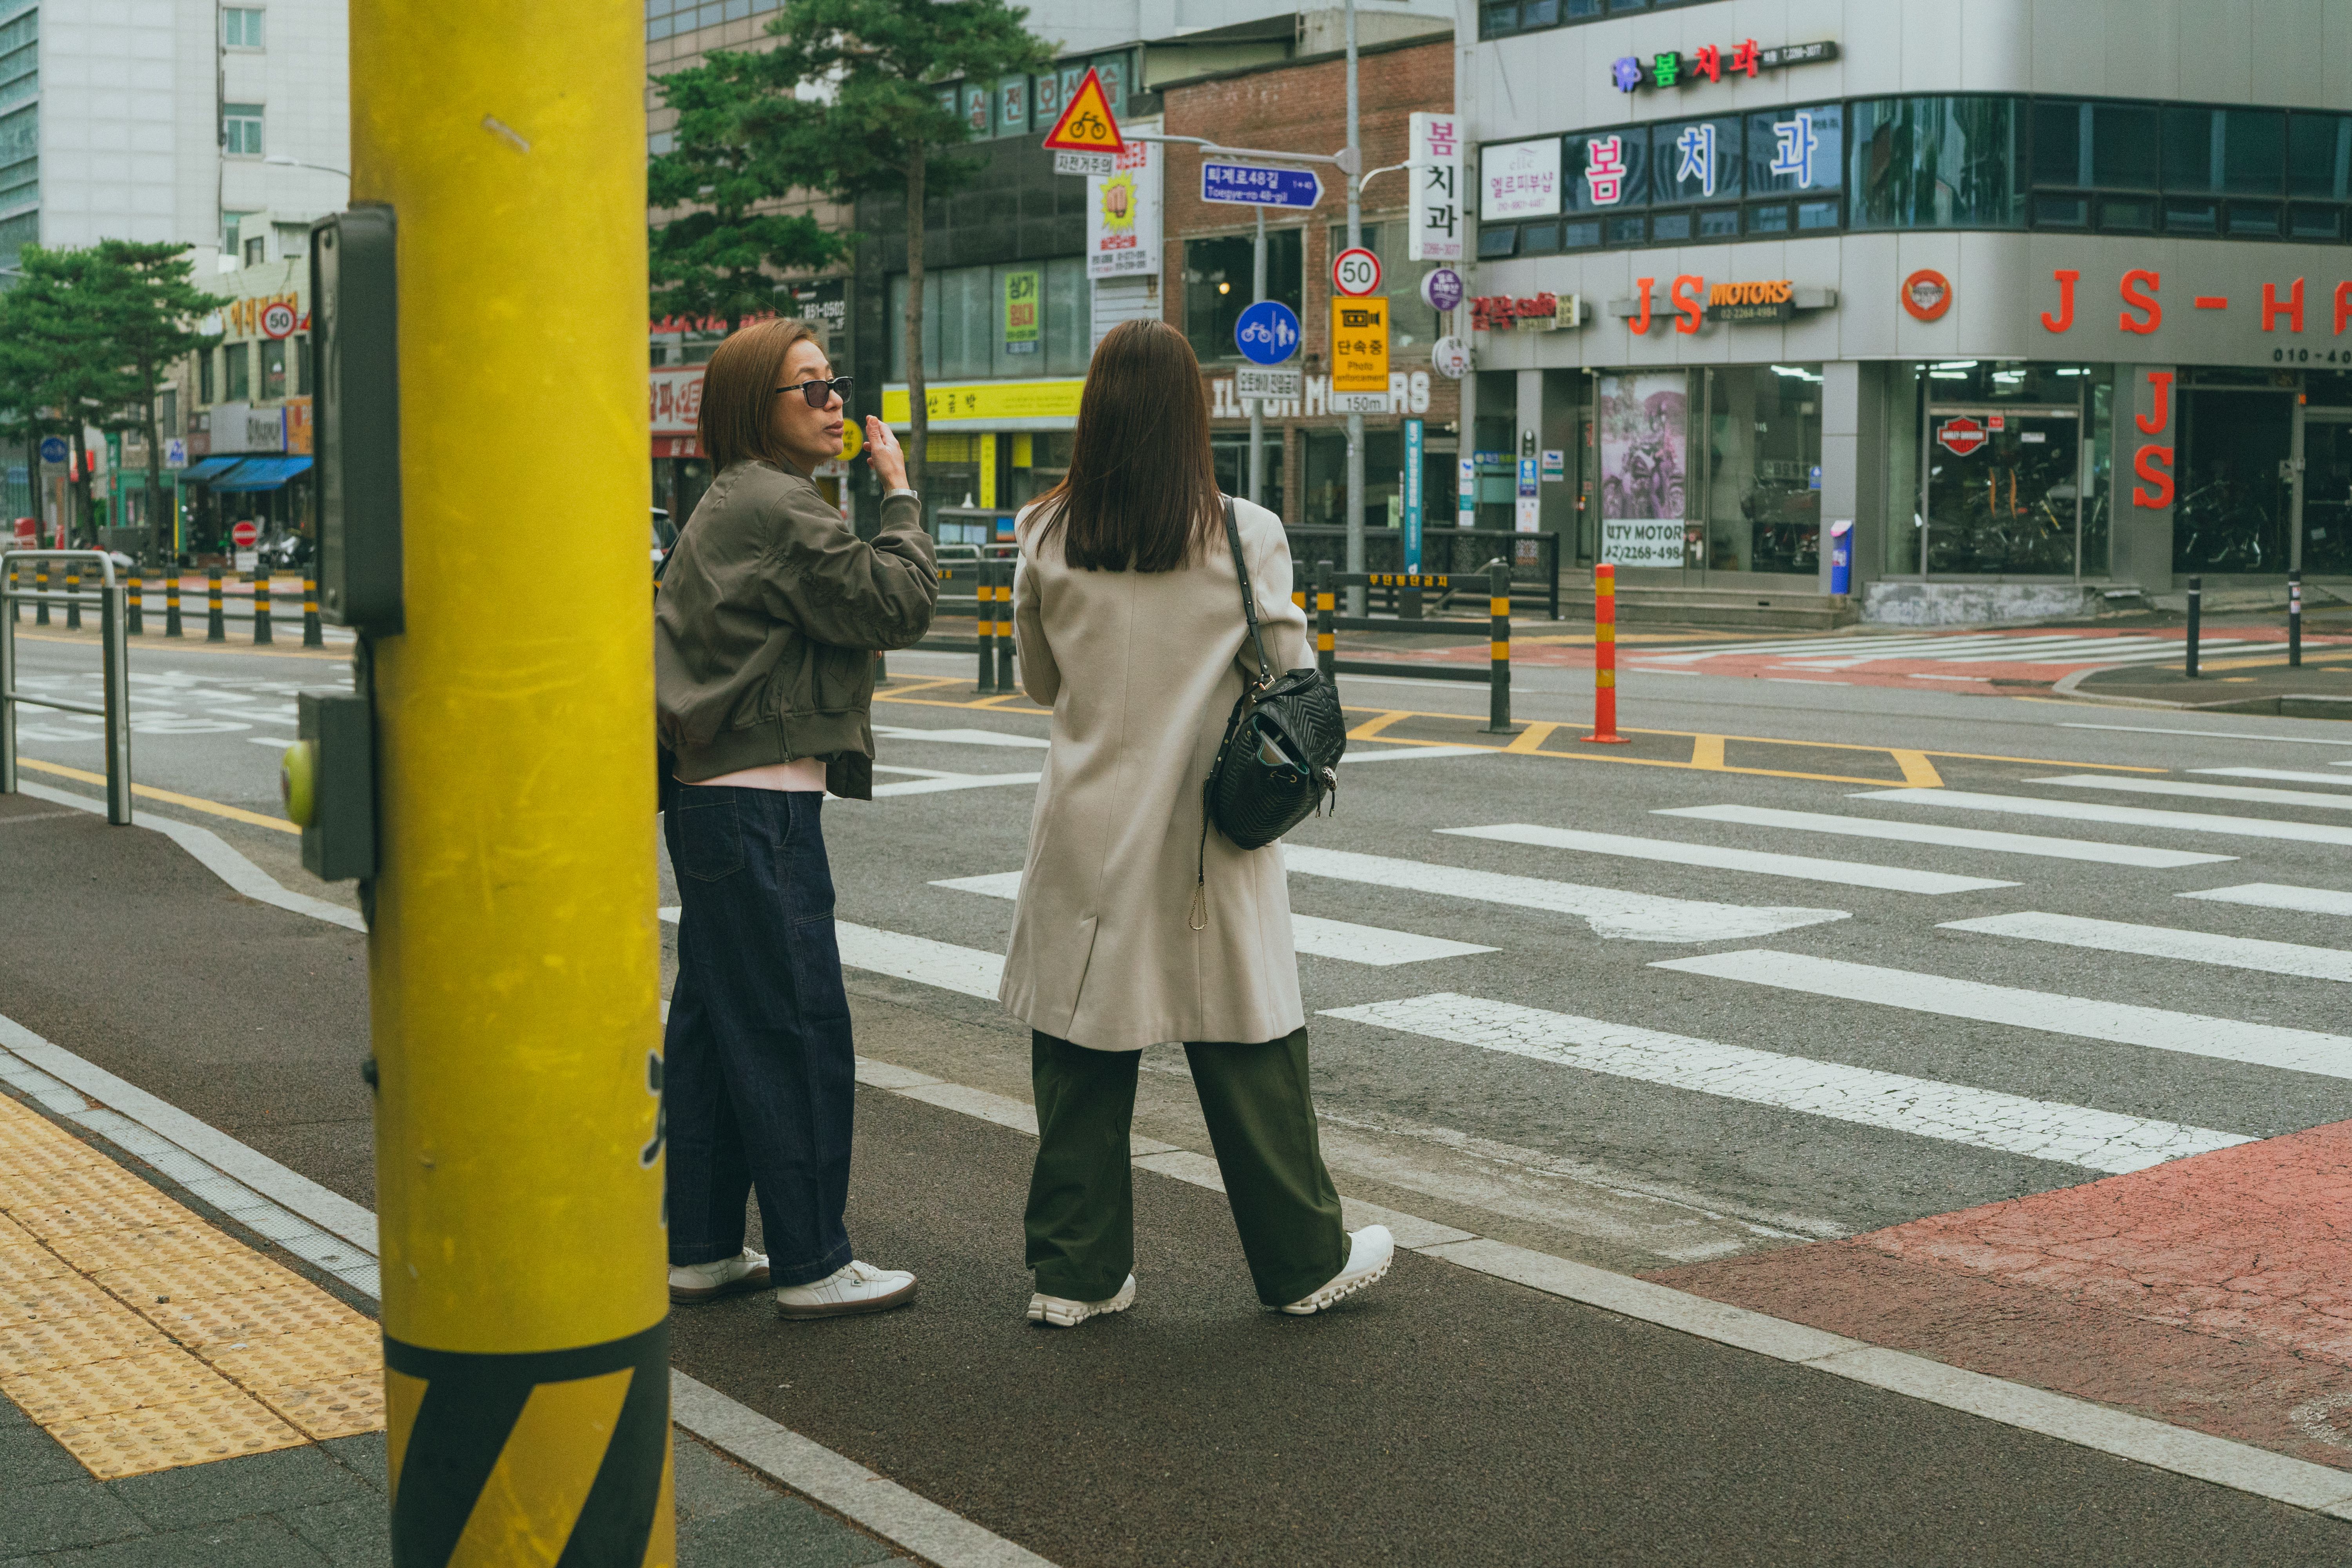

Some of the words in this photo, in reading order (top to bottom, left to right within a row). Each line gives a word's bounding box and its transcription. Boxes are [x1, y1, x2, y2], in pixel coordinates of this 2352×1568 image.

[1652, 38, 1762, 87] 봄치과
[1059, 155, 1112, 172] 자전거주의
[1585, 112, 1818, 205] 봄치과
[1207, 166, 1279, 189] 퇴계로48길
[1426, 122, 1457, 238] 봄치과
[1491, 171, 1553, 198] 엘르피부샵
[1208, 185, 1258, 201] Toegye-ro
[1342, 261, 1371, 284] 50
[1628, 274, 1704, 336] JS
[1709, 279, 1793, 307] MOTORS
[270, 312, 289, 328] 50
[1337, 339, 1382, 355] 단속중
[1347, 361, 1374, 370] Photo
[1336, 373, 1385, 383] enforcement
[1346, 396, 1381, 411] 150m
[2133, 371, 2175, 509] JS
